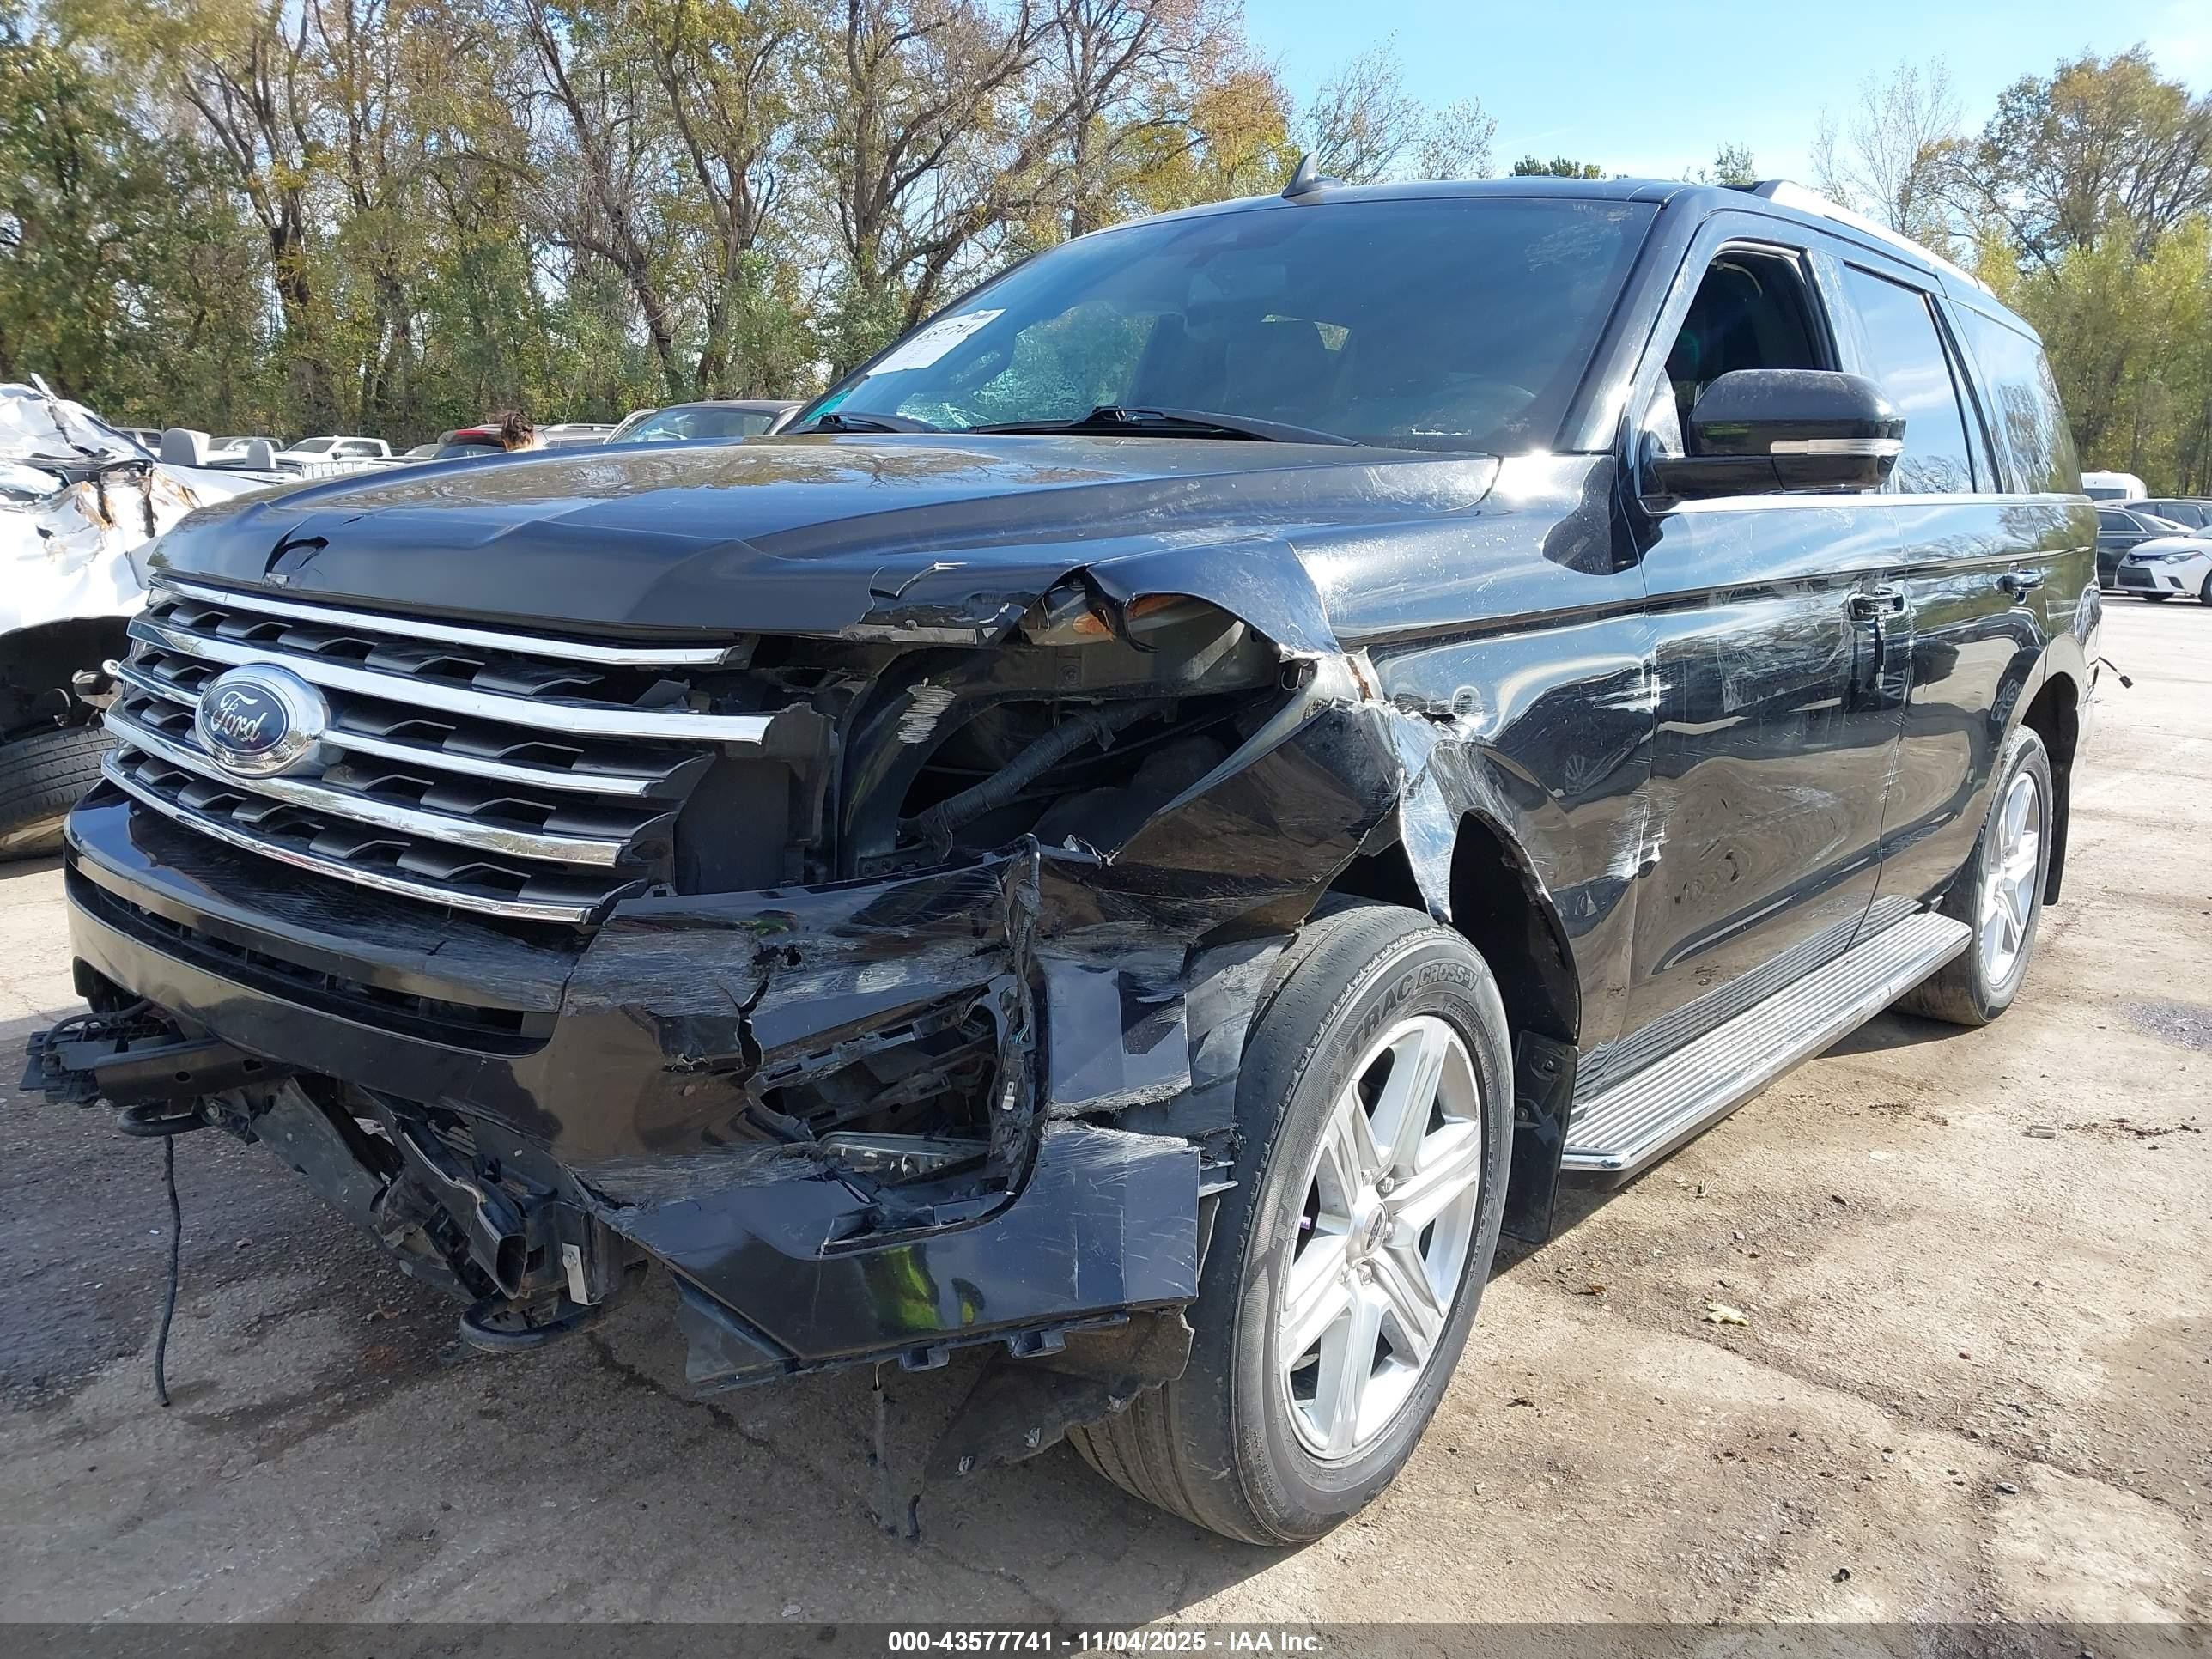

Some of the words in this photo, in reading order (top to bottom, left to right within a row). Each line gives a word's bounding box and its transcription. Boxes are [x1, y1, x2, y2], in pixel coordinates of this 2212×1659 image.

[210, 690, 268, 742] Ford
[1346, 974, 1413, 1059] TRAC
[1419, 963, 1477, 991] CROSS-V
